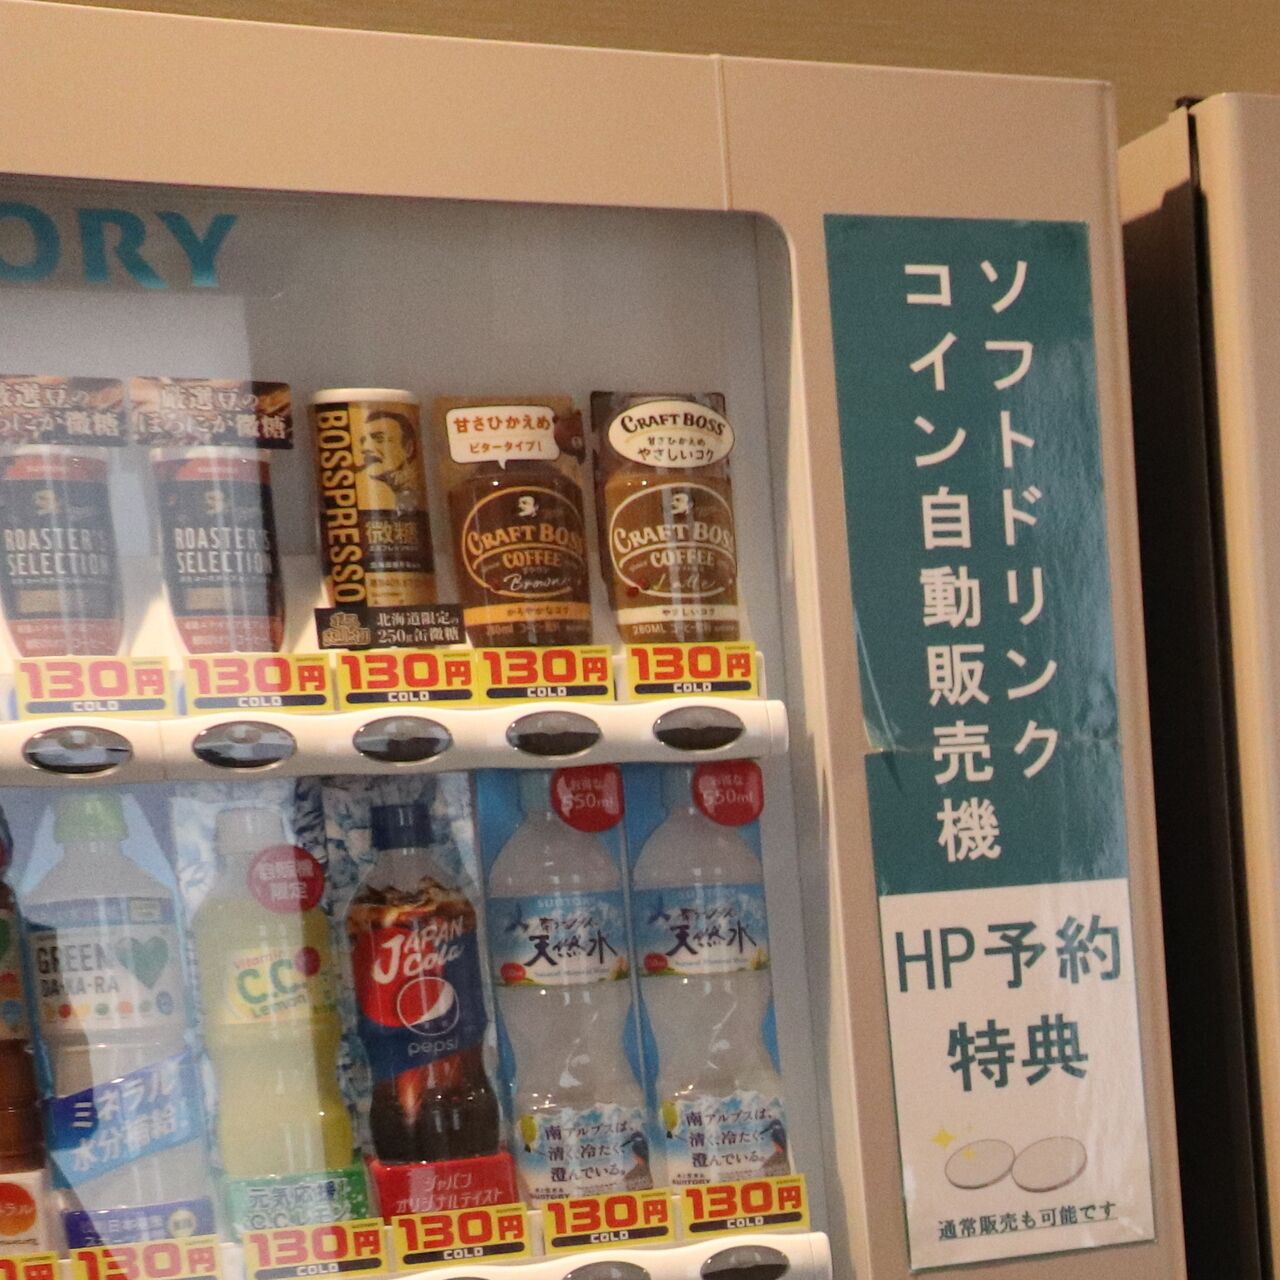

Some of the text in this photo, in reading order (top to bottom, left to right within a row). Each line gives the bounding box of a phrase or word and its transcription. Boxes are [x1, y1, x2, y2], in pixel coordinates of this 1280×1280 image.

[452, 413, 551, 431] 甘さひかえめ
[620, 412, 726, 435] CRAFT BOSS
[318, 408, 366, 604] BOSSPRESSO
[980, 260, 1058, 779] ソフトドリンク
[502, 550, 562, 568] COFFEE
[904, 262, 1002, 863] コイン自動販売機
[341, 653, 472, 689] 130円
[484, 649, 609, 685] 130円
[630, 645, 751, 682] 130円
[388, 691, 430, 702] COLD
[524, 931, 619, 967] 天然水
[894, 914, 1123, 994] HP予約
[407, 1037, 458, 1057] pepsi
[947, 1013, 1088, 1092] 特典
[547, 1200, 668, 1234] 130円
[685, 1180, 802, 1218] 130円
[399, 1210, 524, 1252] 130円
[938, 1201, 1118, 1240] 通常販売も可能です
